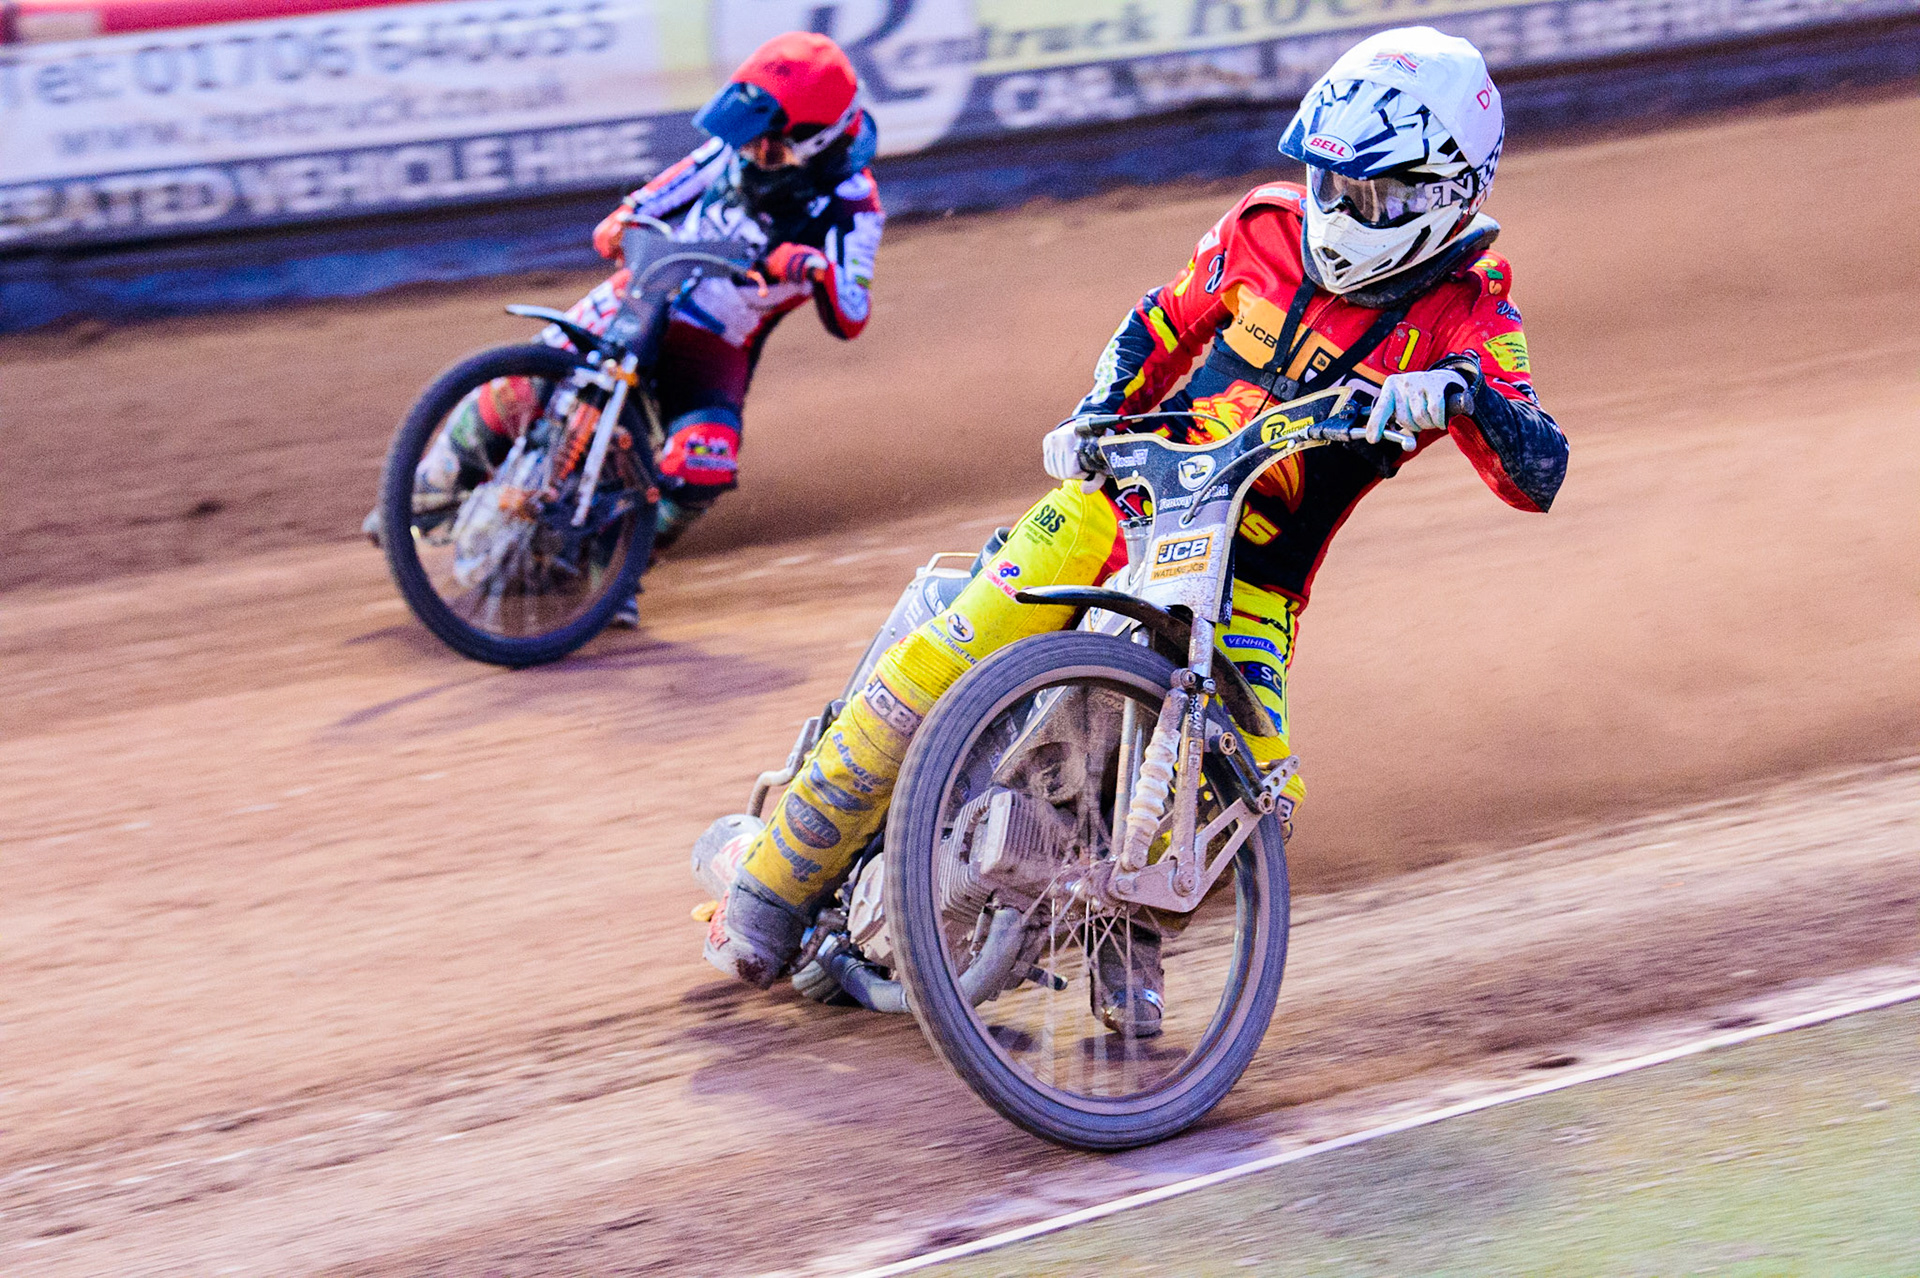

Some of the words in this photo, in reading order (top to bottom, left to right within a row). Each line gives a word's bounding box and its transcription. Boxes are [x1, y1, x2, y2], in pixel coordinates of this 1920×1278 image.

[1309, 137, 1346, 157] BELL
[1245, 322, 1278, 349] JCB
[1034, 504, 1066, 533] SBS
[1158, 538, 1208, 563] JCB
[1228, 636, 1272, 651] VENHILL
